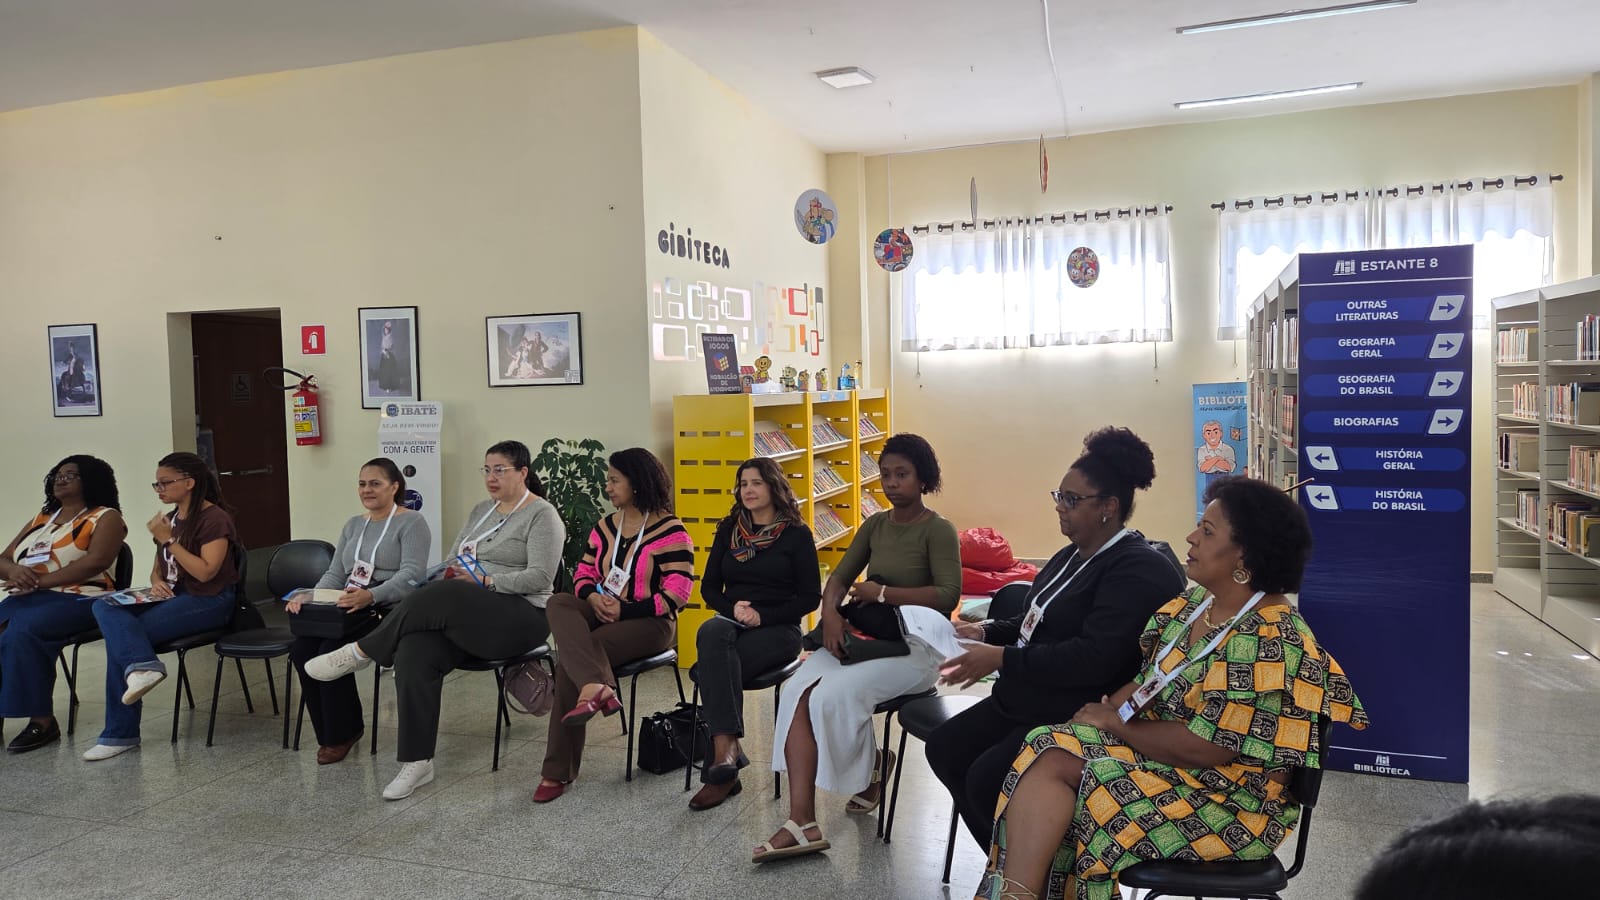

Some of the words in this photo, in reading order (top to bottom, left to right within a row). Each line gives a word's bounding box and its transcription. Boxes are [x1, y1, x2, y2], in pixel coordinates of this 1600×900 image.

[1360, 258, 1426, 272] ESTANTE
[1429, 258, 1439, 268] 8
[1346, 300, 1388, 310] OUTRAS
[1335, 311, 1399, 322] LITERATURAS
[1338, 337, 1396, 347] GEOGRAFIA
[1350, 349, 1383, 358] GERAL
[1337, 375, 1395, 384] GEOGRAFIA
[1340, 387, 1356, 396] DO
[1358, 386, 1393, 395] BRASIL
[1333, 417, 1399, 427] BIOGRAFIAS
[383, 446, 401, 454] COM
[403, 446, 409, 454] A
[410, 445, 435, 454] GENTE
[1375, 448, 1423, 459] HISTÓRIA
[1383, 461, 1416, 470] GERAL
[1375, 488, 1423, 500] HISTÓRIA
[1372, 501, 1388, 510] DO
[1391, 501, 1427, 511] BRASIL
[1353, 763, 1411, 776] BIBLIOTECA
